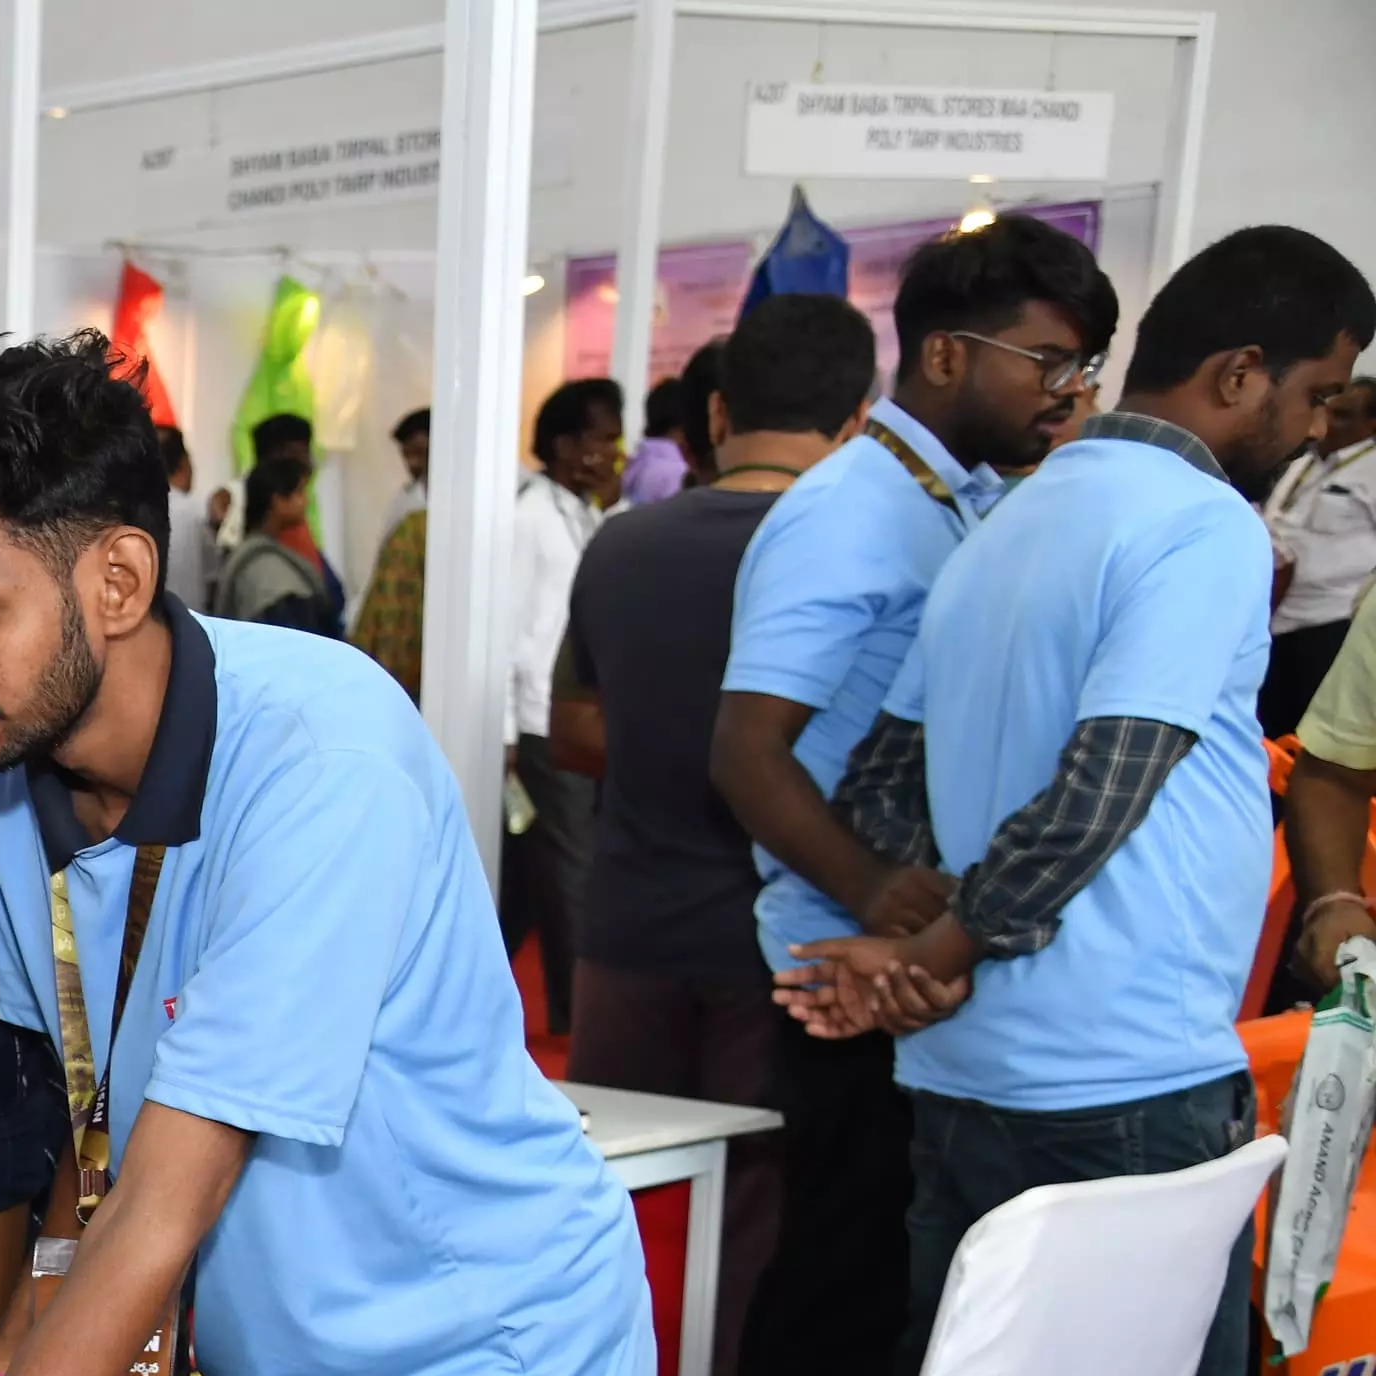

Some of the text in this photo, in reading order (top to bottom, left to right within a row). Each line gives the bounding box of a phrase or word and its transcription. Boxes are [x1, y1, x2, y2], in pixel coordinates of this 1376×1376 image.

[943, 96, 996, 119] STORES
[946, 129, 1025, 154] INDUSTRIES
[1313, 1121, 1334, 1184] ANAND
